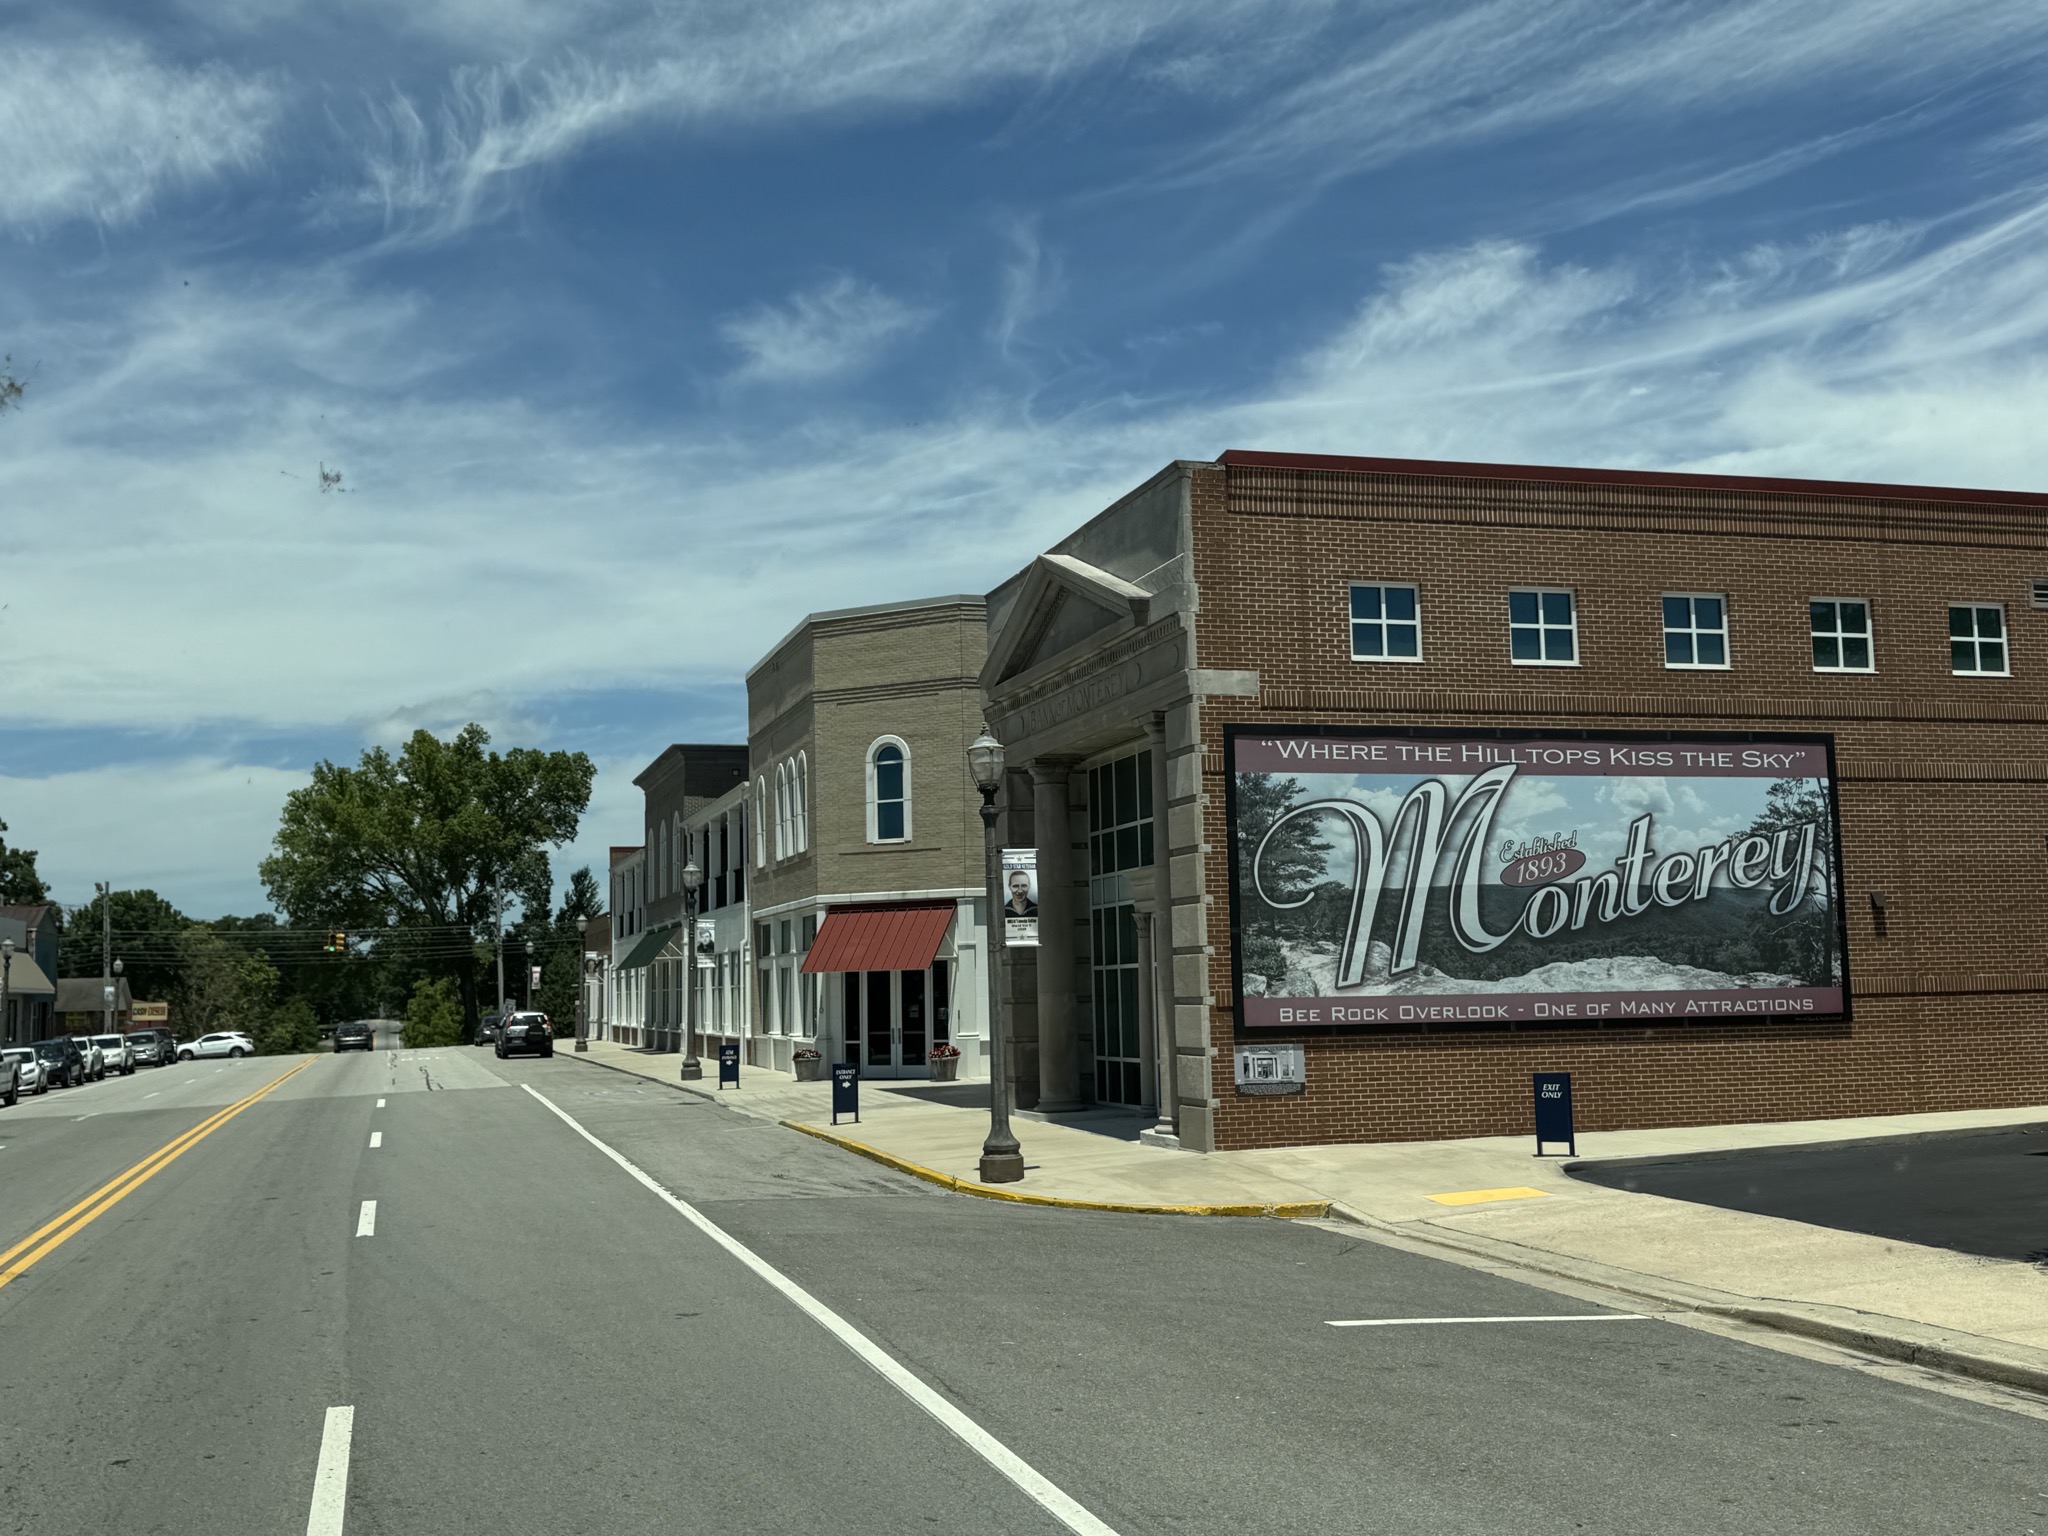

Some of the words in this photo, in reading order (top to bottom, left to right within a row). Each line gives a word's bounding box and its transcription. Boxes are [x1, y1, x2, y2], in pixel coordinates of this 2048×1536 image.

[1029, 705, 1057, 732] BANK
[1066, 670, 1125, 716] MONTEREY
[1395, 745, 1452, 763] THE
[1461, 744, 1601, 765] HILLTOPS
[1609, 748, 1674, 766] KISS
[1680, 751, 1734, 768] THE
[1499, 829, 1578, 864] Established
[1253, 763, 1818, 990] Monterey
[1516, 852, 1567, 884] 1893
[1279, 1007, 1321, 1023] BEE
[1331, 1006, 1389, 1021] ROCK
[1399, 1005, 1509, 1020] OVERLOOK
[1534, 1002, 1577, 1017] ONE
[1586, 1003, 1611, 1016] OF
[1620, 1001, 1676, 1015] MANY
[1685, 998, 1814, 1013] ATTRACTIONS
[1542, 1083, 1560, 1091] EXIT
